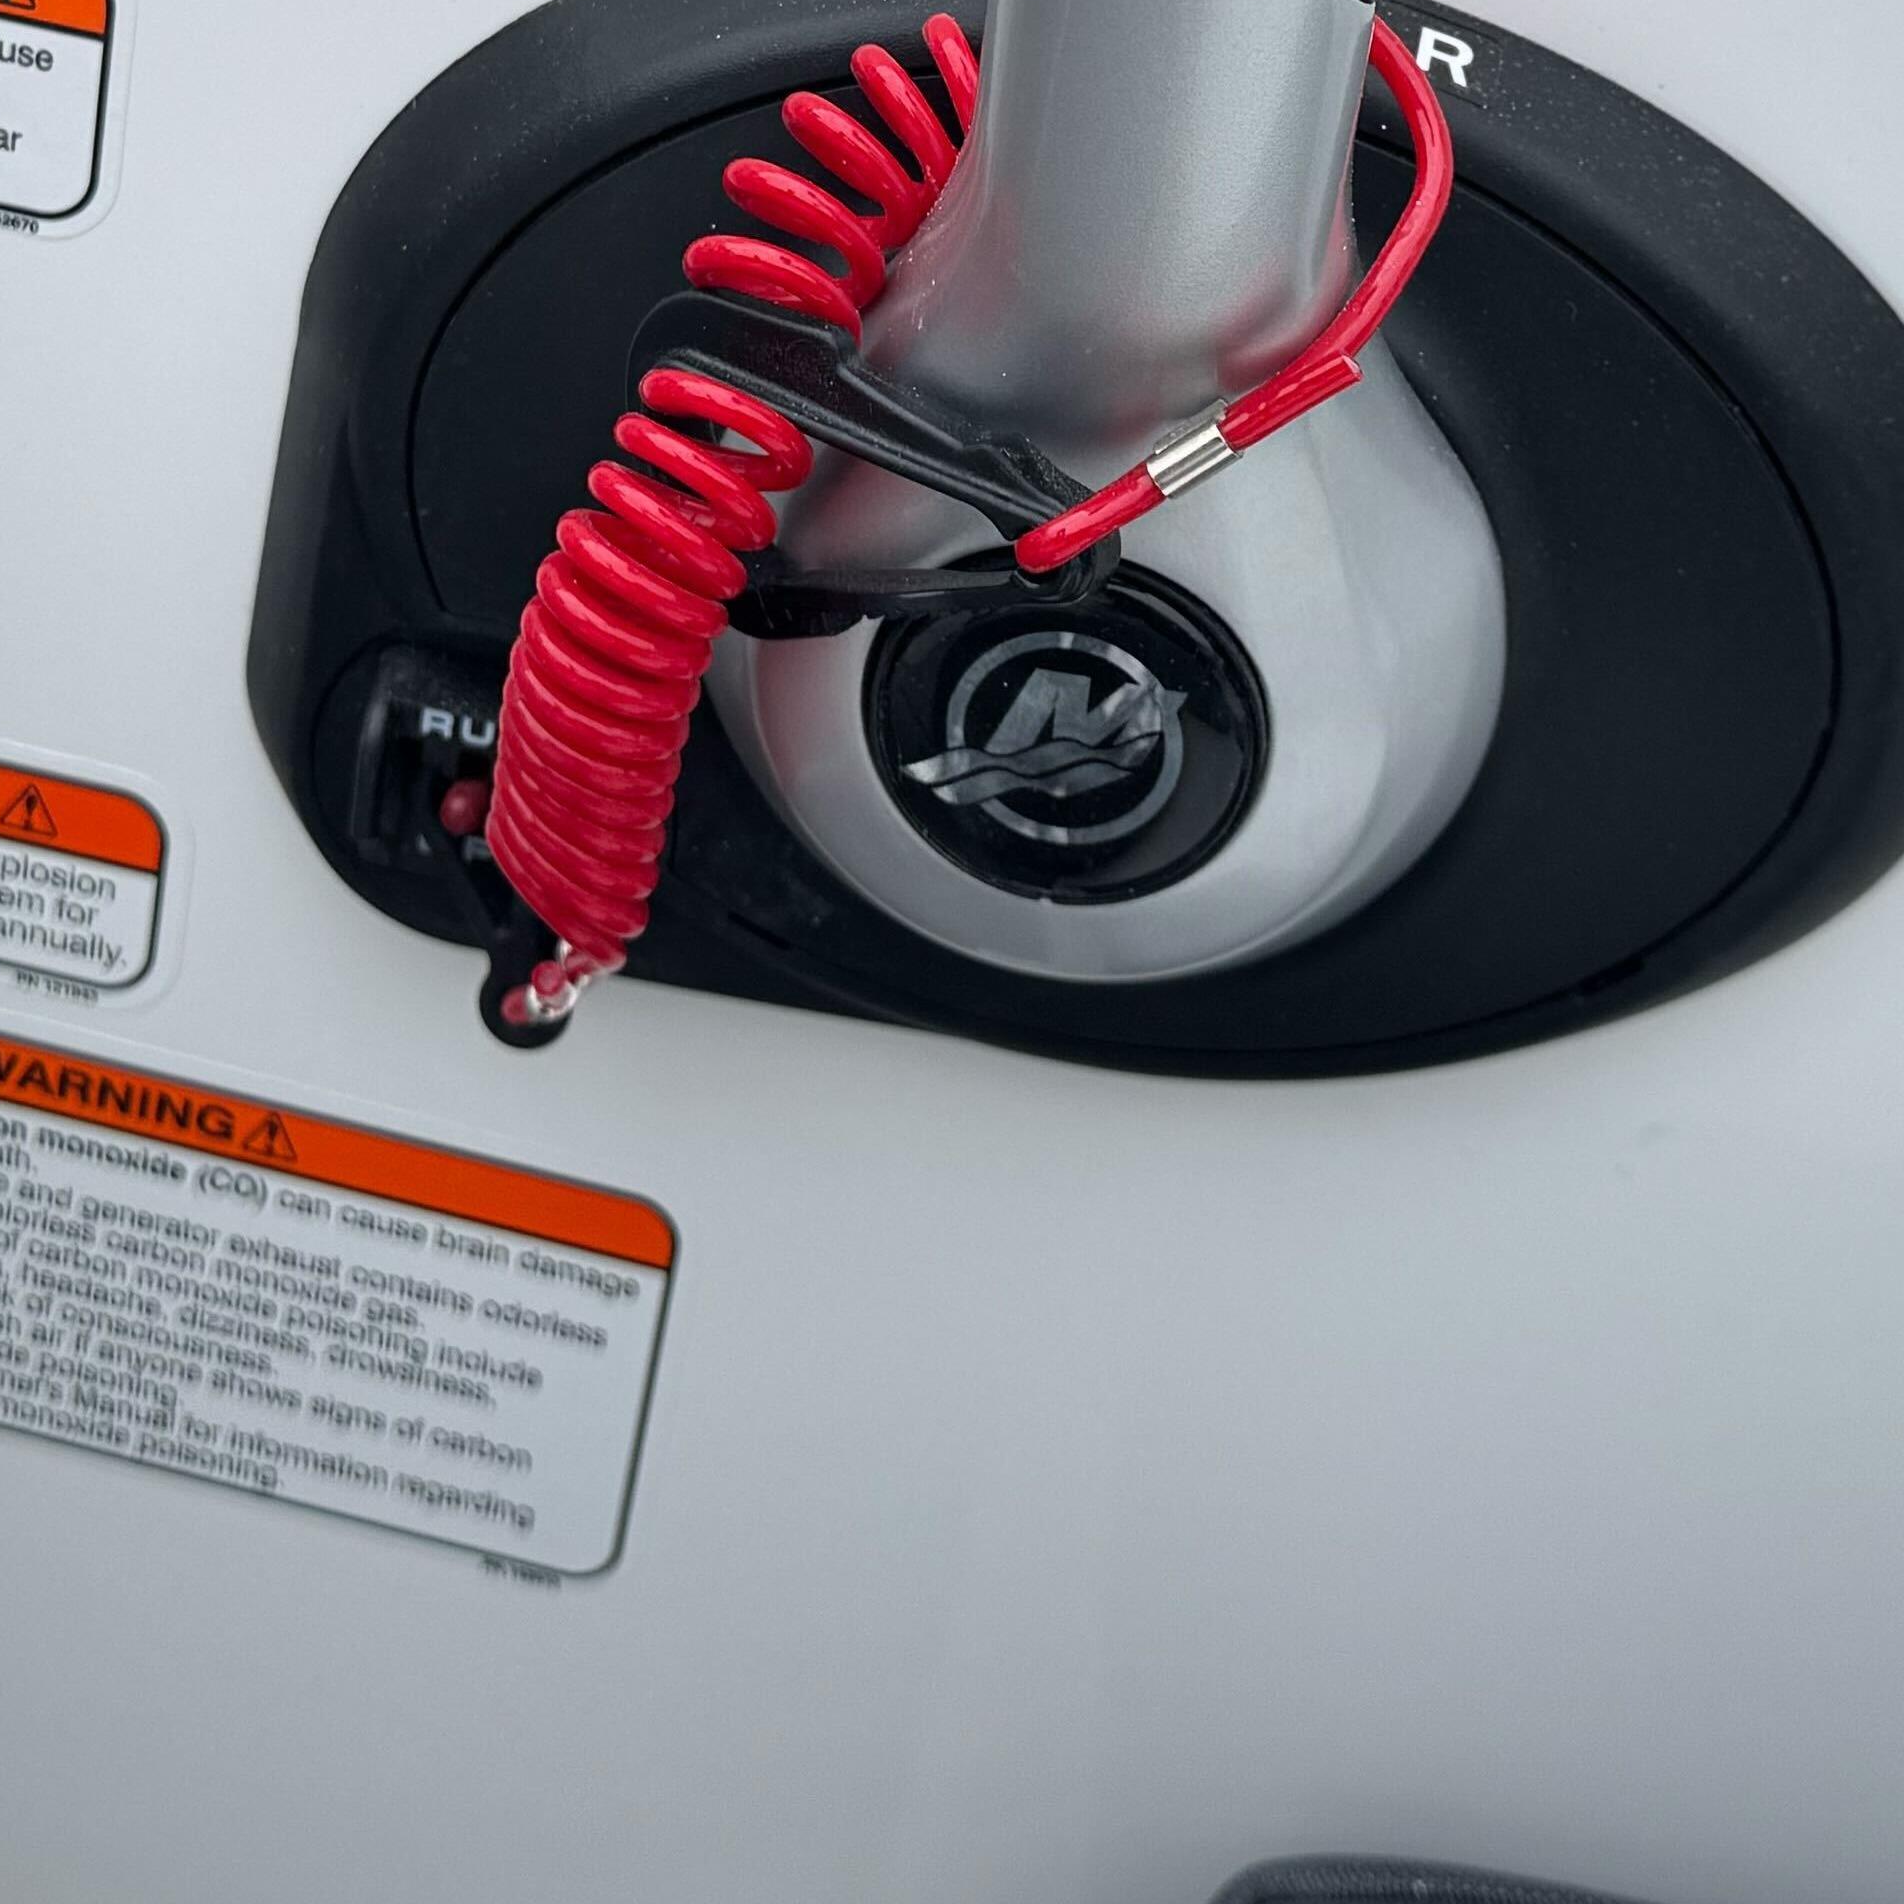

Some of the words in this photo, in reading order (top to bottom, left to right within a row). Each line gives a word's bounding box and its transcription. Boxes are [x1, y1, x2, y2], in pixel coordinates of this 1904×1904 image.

[1416, 26, 1474, 87] R
[421, 707, 495, 746] RU
[56, 892, 98, 928] for
[18, 1175, 72, 1209] and
[80, 1193, 220, 1249] generator
[229, 1229, 342, 1280] exhaust
[351, 1260, 474, 1315] contains
[483, 1294, 609, 1349] odorless
[38, 1122, 188, 1184] monoxide
[197, 1161, 270, 1208] (CO)
[279, 1187, 332, 1221] can
[341, 1203, 428, 1245] cause
[436, 1223, 511, 1267] brain
[519, 1244, 641, 1303] damage
[26, 1291, 53, 1318] of
[28, 1232, 127, 1281] carbon
[136, 1262, 279, 1319] monoxide
[284, 1302, 429, 1364] poisoning
[437, 1339, 544, 1391] include
[105, 1227, 206, 1273] carbon
[214, 1255, 358, 1313] monoxide
[366, 1293, 426, 1331] gas.
[32, 1316, 62, 1346] air
[98, 1336, 202, 1386] anyone
[210, 1366, 302, 1411] shows
[310, 1392, 388, 1436] signs
[396, 1412, 425, 1441] of
[431, 1422, 533, 1471] carbon
[73, 1381, 175, 1431] Manual
[182, 1411, 222, 1445] for
[229, 1423, 389, 1489] information
[397, 1471, 536, 1531] regarding
